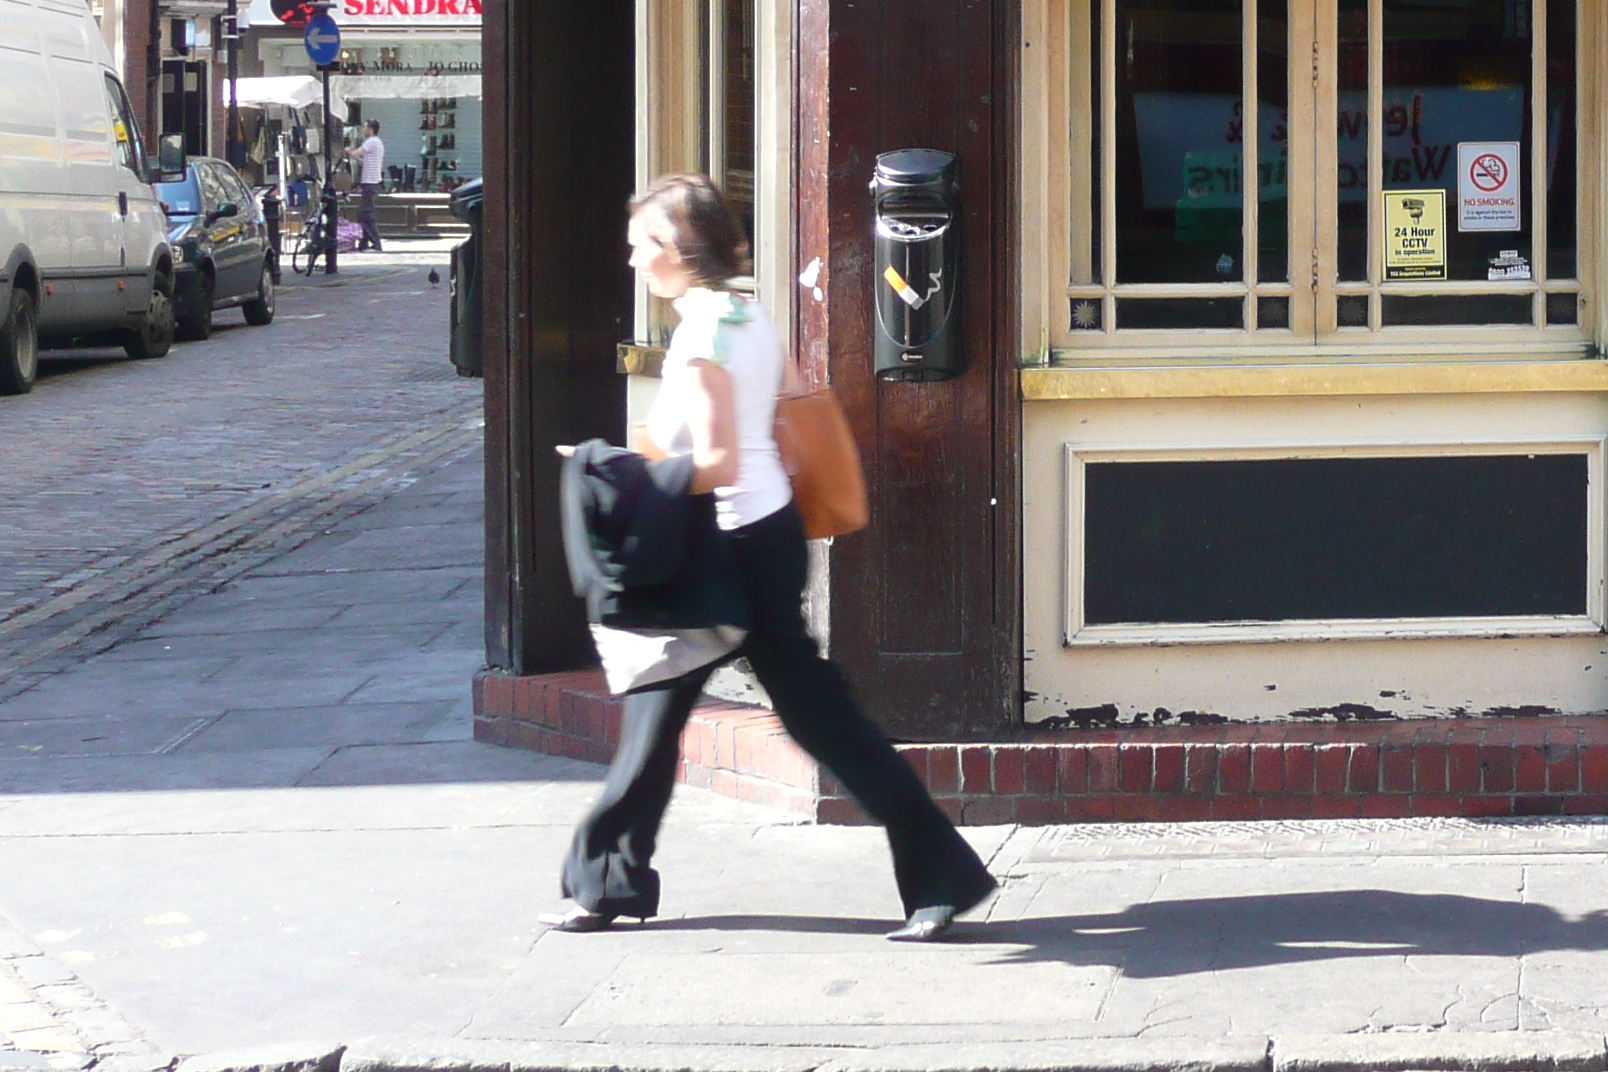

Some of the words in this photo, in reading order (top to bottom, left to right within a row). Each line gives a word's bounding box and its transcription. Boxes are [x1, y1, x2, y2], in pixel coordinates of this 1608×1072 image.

[448, 60, 483, 73] GHO
[1463, 197, 1476, 207] NO
[1394, 227, 1407, 237] 24
[1411, 227, 1436, 237] Hour
[1402, 238, 1428, 248] CCTV
[1403, 249, 1435, 257] operation
